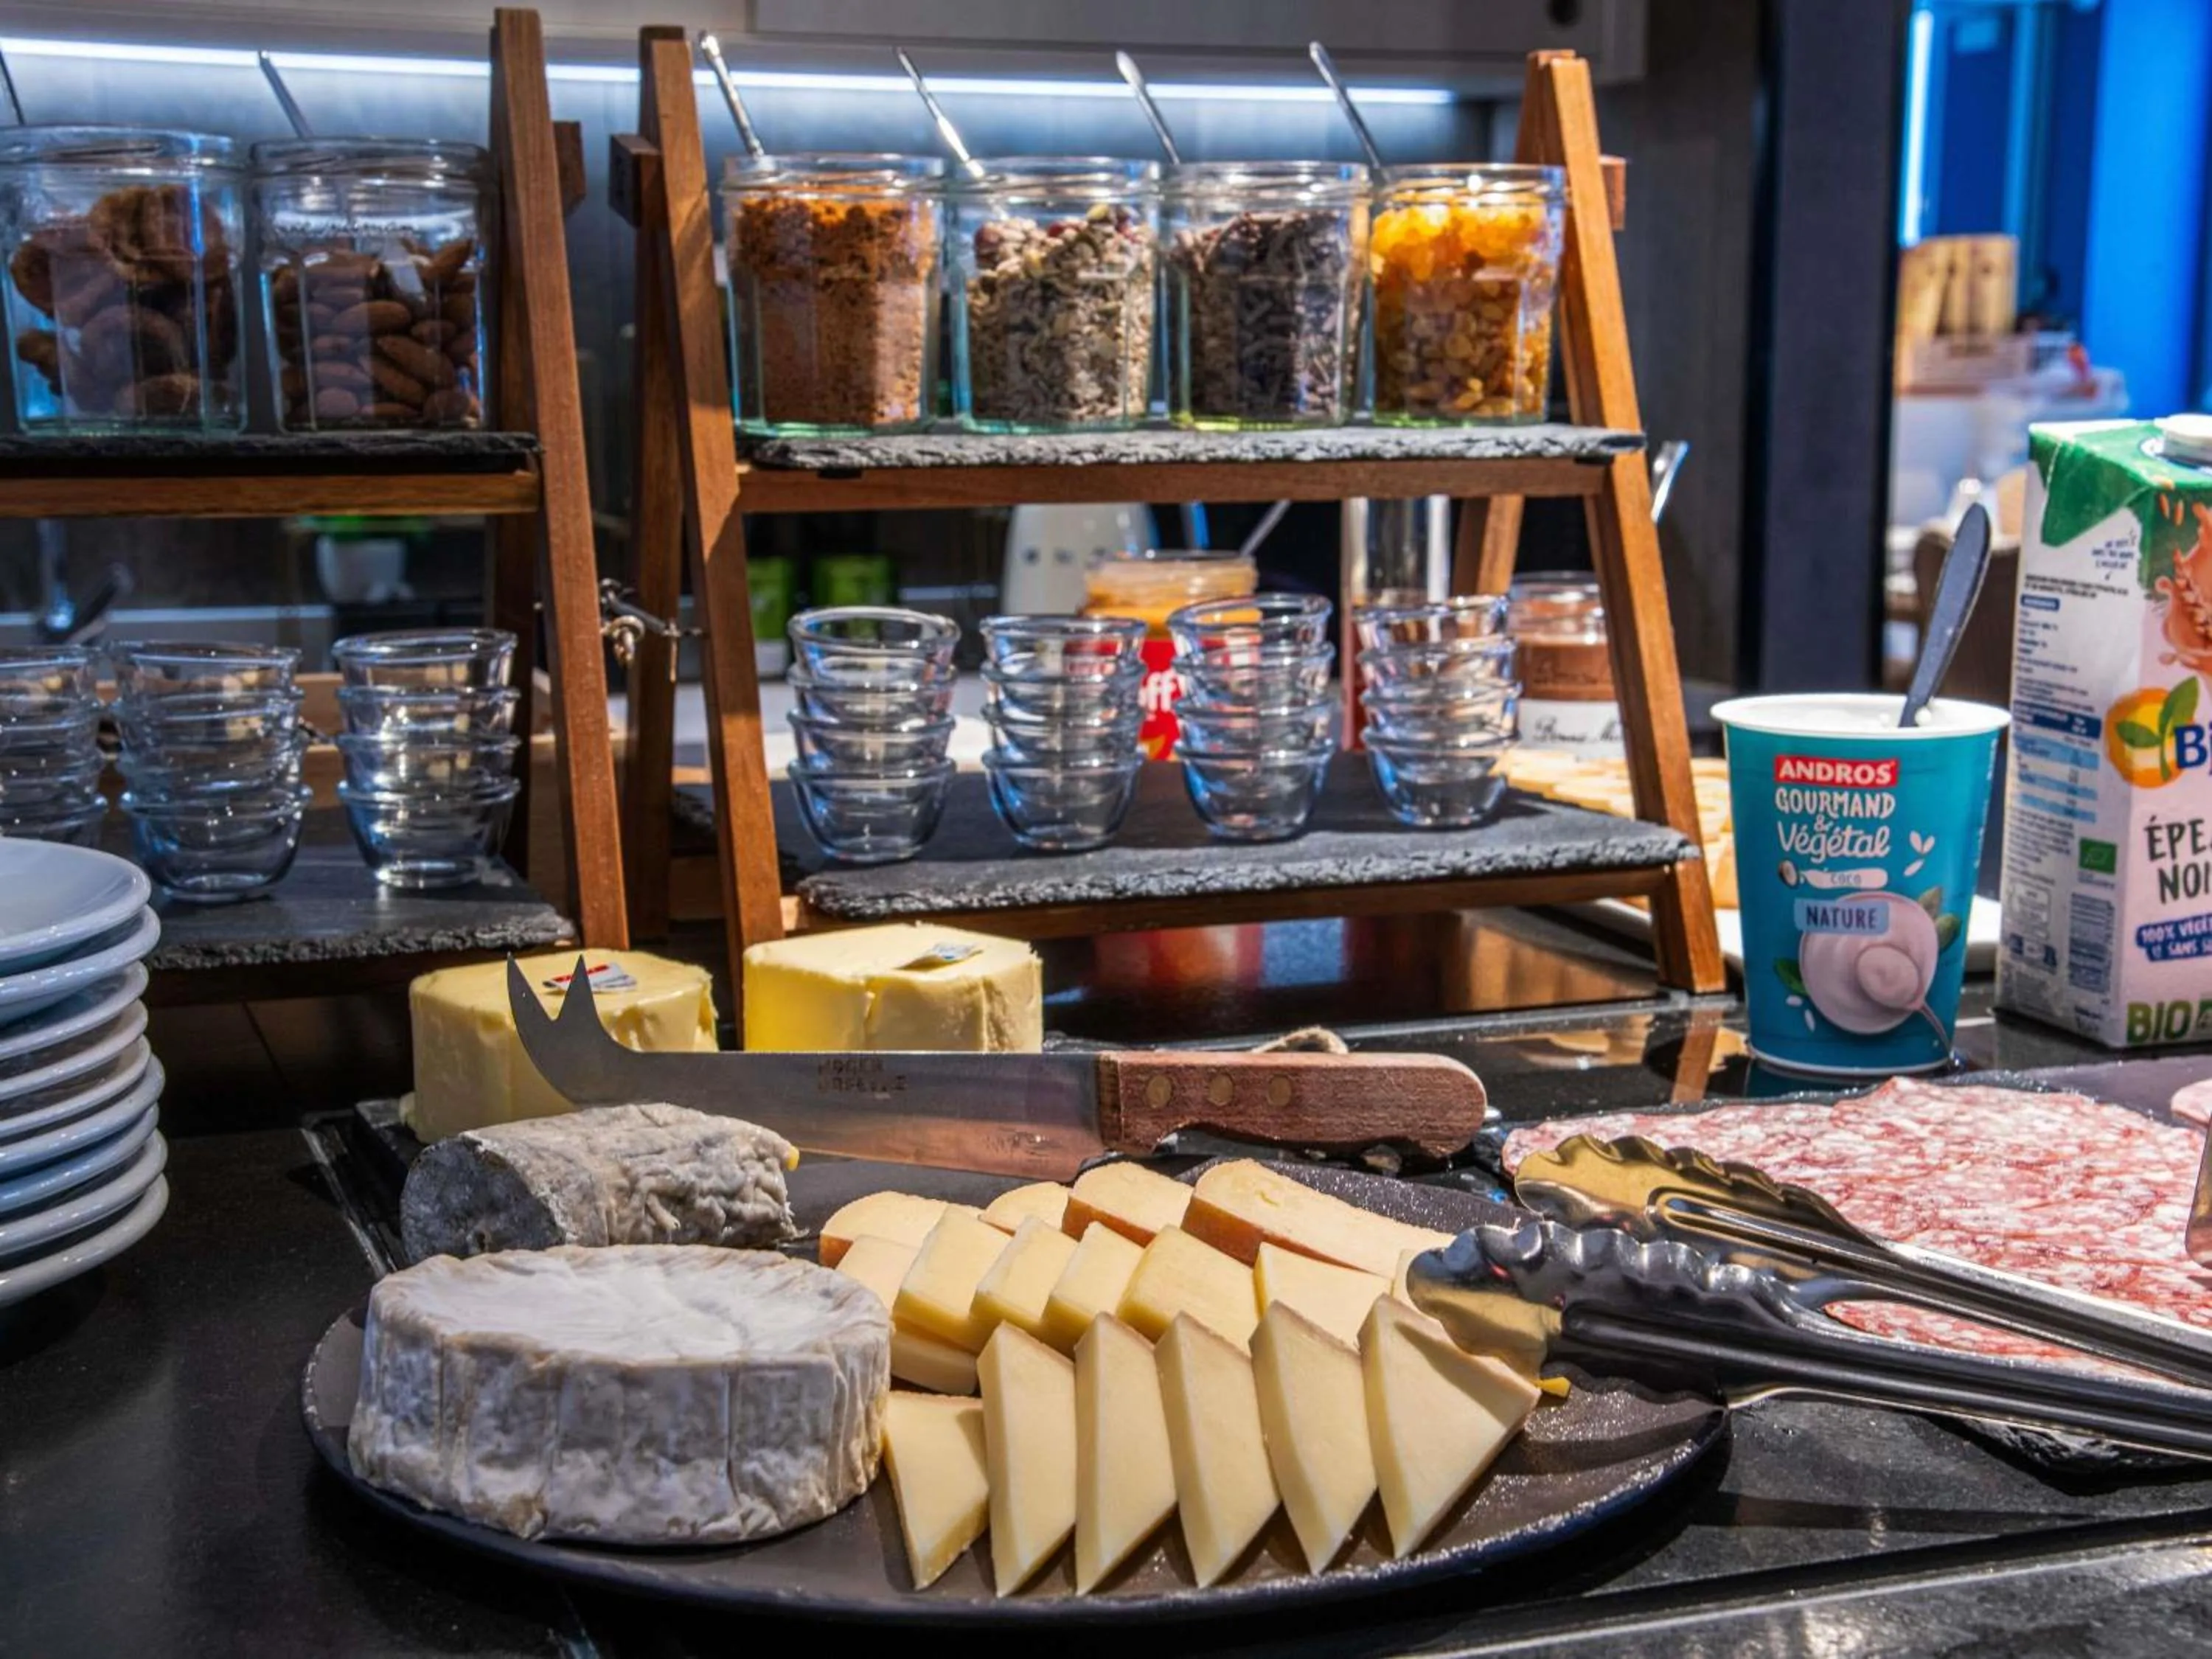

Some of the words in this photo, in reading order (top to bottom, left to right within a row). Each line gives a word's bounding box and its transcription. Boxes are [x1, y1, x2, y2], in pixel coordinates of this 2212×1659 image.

[1778, 759, 1892, 785] ANDROS
[1775, 787, 1896, 819] GOURMAND
[1814, 814, 1834, 832] &
[1777, 820, 1891, 864] Végétal
[2144, 815, 2212, 862] ÉPE
[1806, 905, 1877, 930] NATURE
